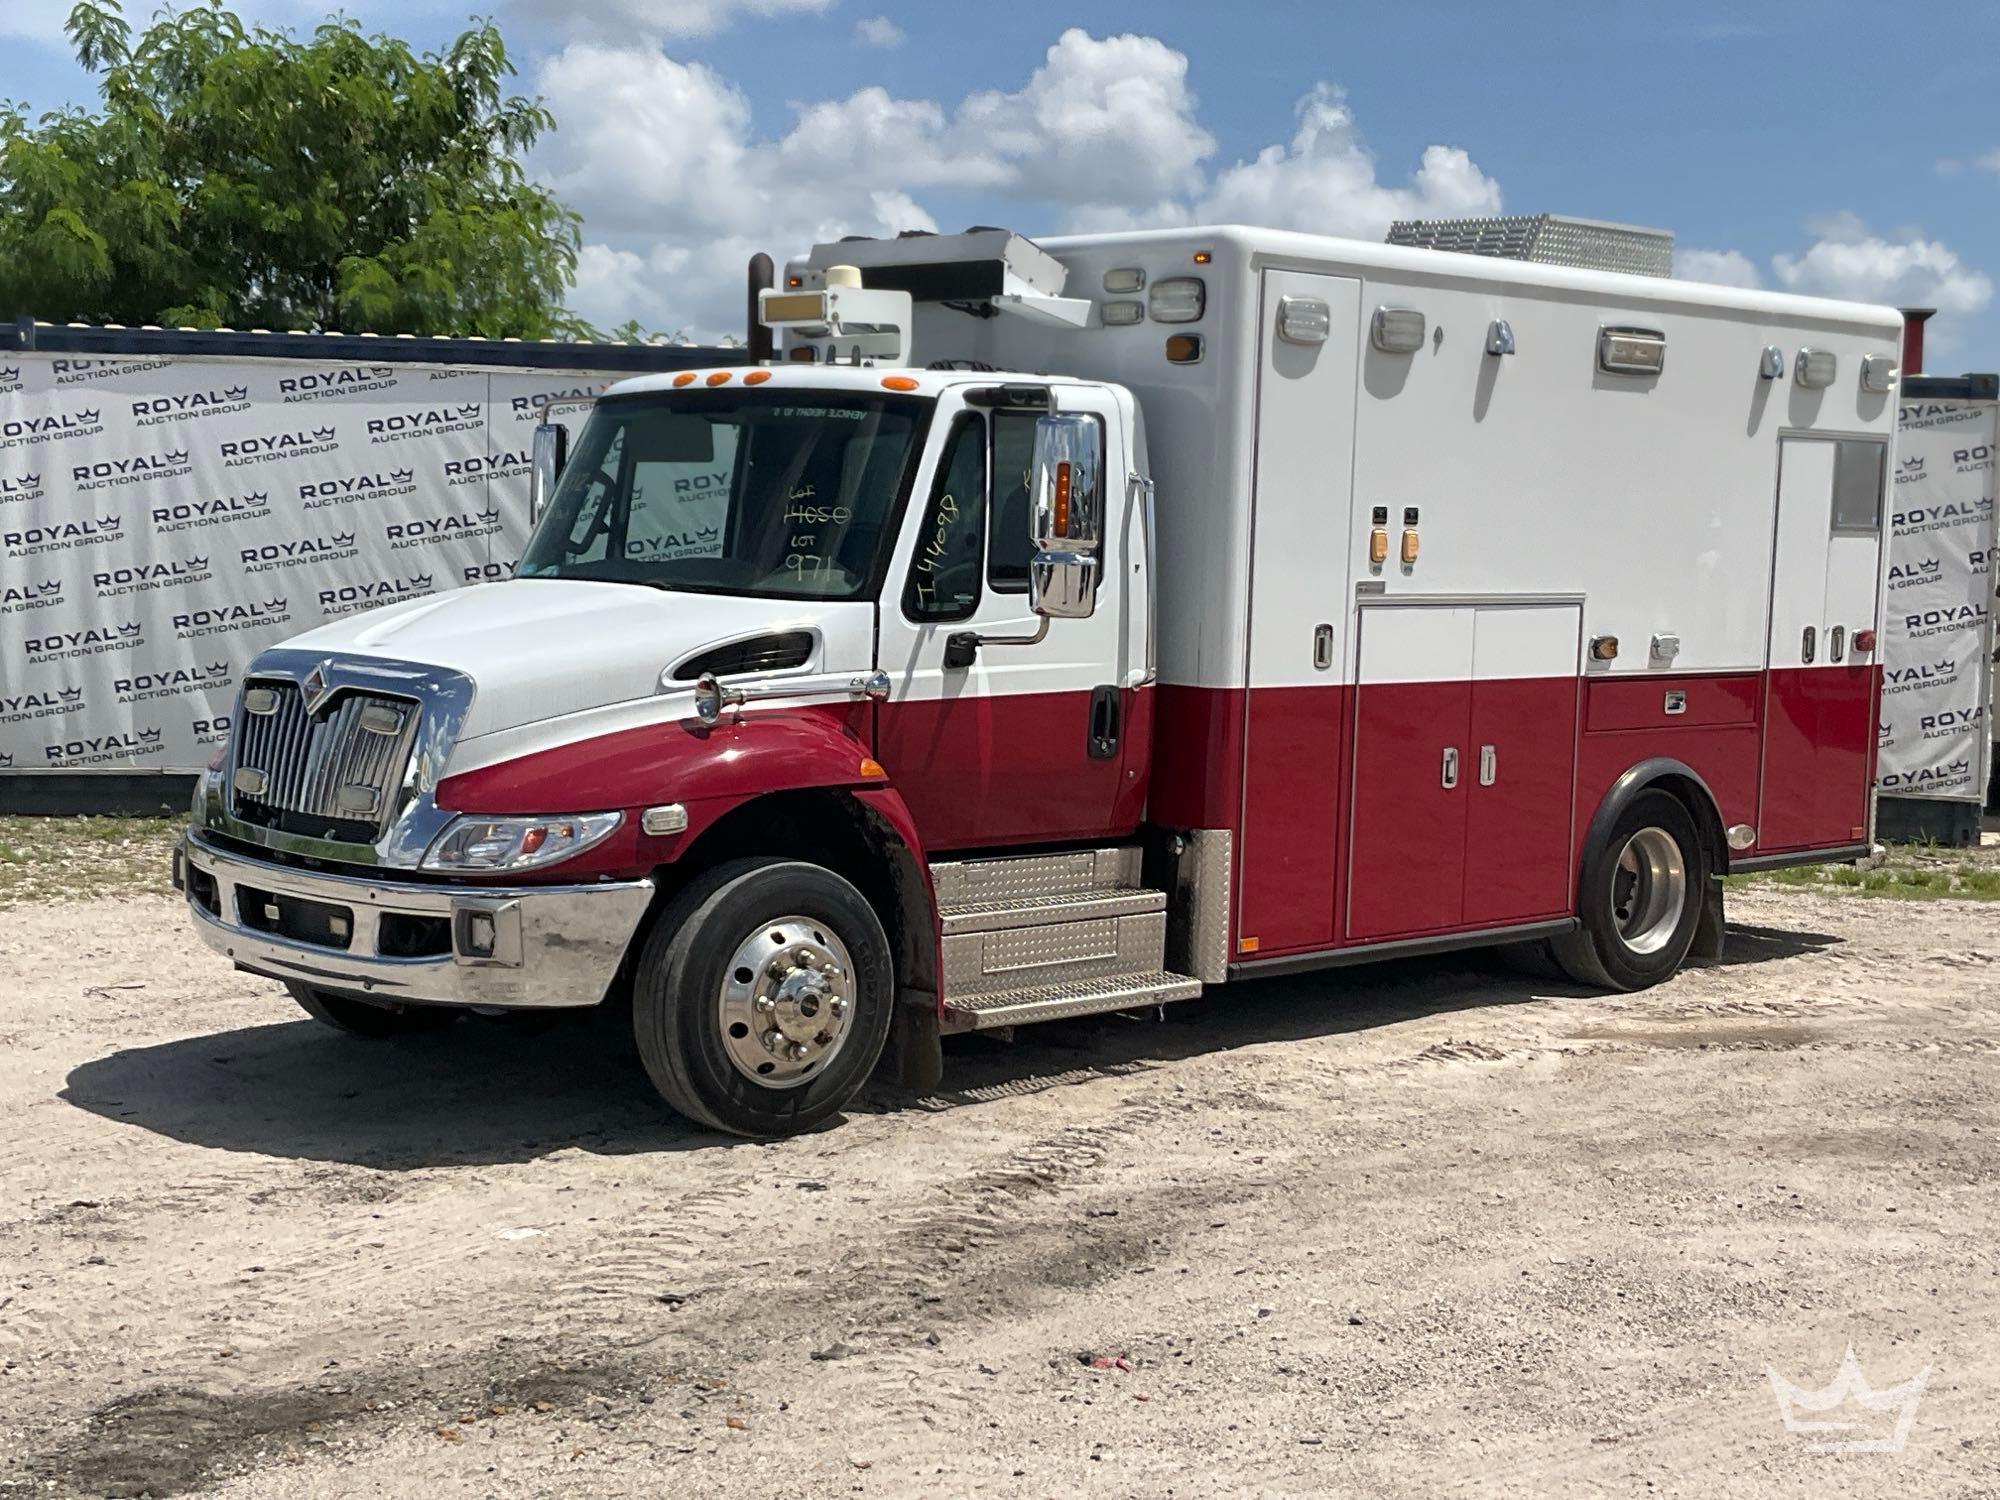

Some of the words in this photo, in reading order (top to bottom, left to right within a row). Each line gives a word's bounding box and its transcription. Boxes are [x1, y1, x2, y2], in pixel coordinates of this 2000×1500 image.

[56, 368, 119, 384] AUCTION
[280, 368, 370, 392] ROYAL
[132, 391, 224, 416] ROYAL
[283, 388, 346, 404] AUCTION
[348, 380, 398, 393] GROUP
[0, 414, 76, 438] OYAL
[136, 409, 199, 427] AUCTION
[202, 402, 251, 416] GROUP
[368, 409, 458, 434] ROYAL
[1936, 411, 1982, 424] GROUP
[0, 434, 50, 449] UCTION
[54, 426, 104, 440] GROUP
[372, 429, 432, 444] AUCTION
[436, 420, 484, 434] GROUP
[221, 432, 313, 457] ROYAL
[224, 452, 287, 467] AUCTION
[290, 443, 339, 457] GROUP
[73, 454, 166, 481] ROYAL
[445, 452, 532, 476] ROYAL
[76, 475, 140, 492] AUCTION
[143, 467, 192, 481] GROUP
[300, 474, 390, 499] ROYAL
[448, 471, 510, 486] AUCTION
[674, 472, 728, 493] ROY
[1895, 473, 1928, 484] ROUP
[303, 492, 365, 510] AUCTION
[368, 485, 417, 499] GROUP
[678, 488, 731, 504] AUCTIO
[152, 497, 245, 523] ROYAL
[156, 517, 219, 534] AUCTION
[222, 509, 272, 524] GROUP
[1892, 502, 1973, 527] ROYAL
[4, 521, 98, 547] ROYAL
[387, 514, 476, 539] ROYAL
[390, 533, 452, 550] AUCTION
[454, 526, 504, 539] GROUP
[1892, 521, 1950, 538] AUCTION
[1952, 514, 1992, 526] GROU
[8, 541, 71, 558] AUCTION
[74, 532, 124, 547] GROUP
[241, 538, 332, 563] ROYAL
[627, 533, 696, 554] OYAL
[674, 544, 722, 557] GROUP
[791, 536, 816, 547] LOT
[244, 558, 306, 574] AUCTION
[310, 549, 358, 564] GROUP
[464, 560, 519, 580] ROY
[785, 554, 832, 581] 971
[94, 561, 186, 587] ROYAL
[97, 581, 161, 598] AUCTION
[164, 572, 212, 587] GROUP
[1897, 574, 1942, 589] GROUP
[318, 579, 410, 604] ROYAL
[16, 597, 64, 612] GROUP
[173, 604, 264, 629] ROYAL
[322, 600, 385, 614] AUCTION
[1906, 604, 1988, 629] ROYAL
[177, 623, 240, 640] AUCTION
[242, 614, 292, 630] GROUP
[1909, 622, 1966, 638] AUCTION
[25, 627, 118, 653] ROYAL
[28, 647, 92, 664] AUCTION
[95, 639, 145, 654] GROUP
[114, 668, 206, 693] ROYAL
[1881, 666, 1934, 686] YAL
[1882, 684, 1911, 696] TION
[1913, 676, 1958, 690] GROUP
[0, 692, 58, 713] YAL
[118, 688, 180, 704] AUCTION
[184, 679, 232, 694] GROUP
[0, 712, 32, 724] TION
[36, 703, 86, 718] GROUP
[1921, 707, 1984, 730] ROYA
[1923, 722, 1980, 739] AUCTION
[46, 734, 138, 760] ROYAL
[51, 753, 113, 768] AUCTION
[116, 744, 165, 758] GROUP
[1883, 766, 1948, 786] OYAL
[1927, 776, 1972, 790] GROUP
